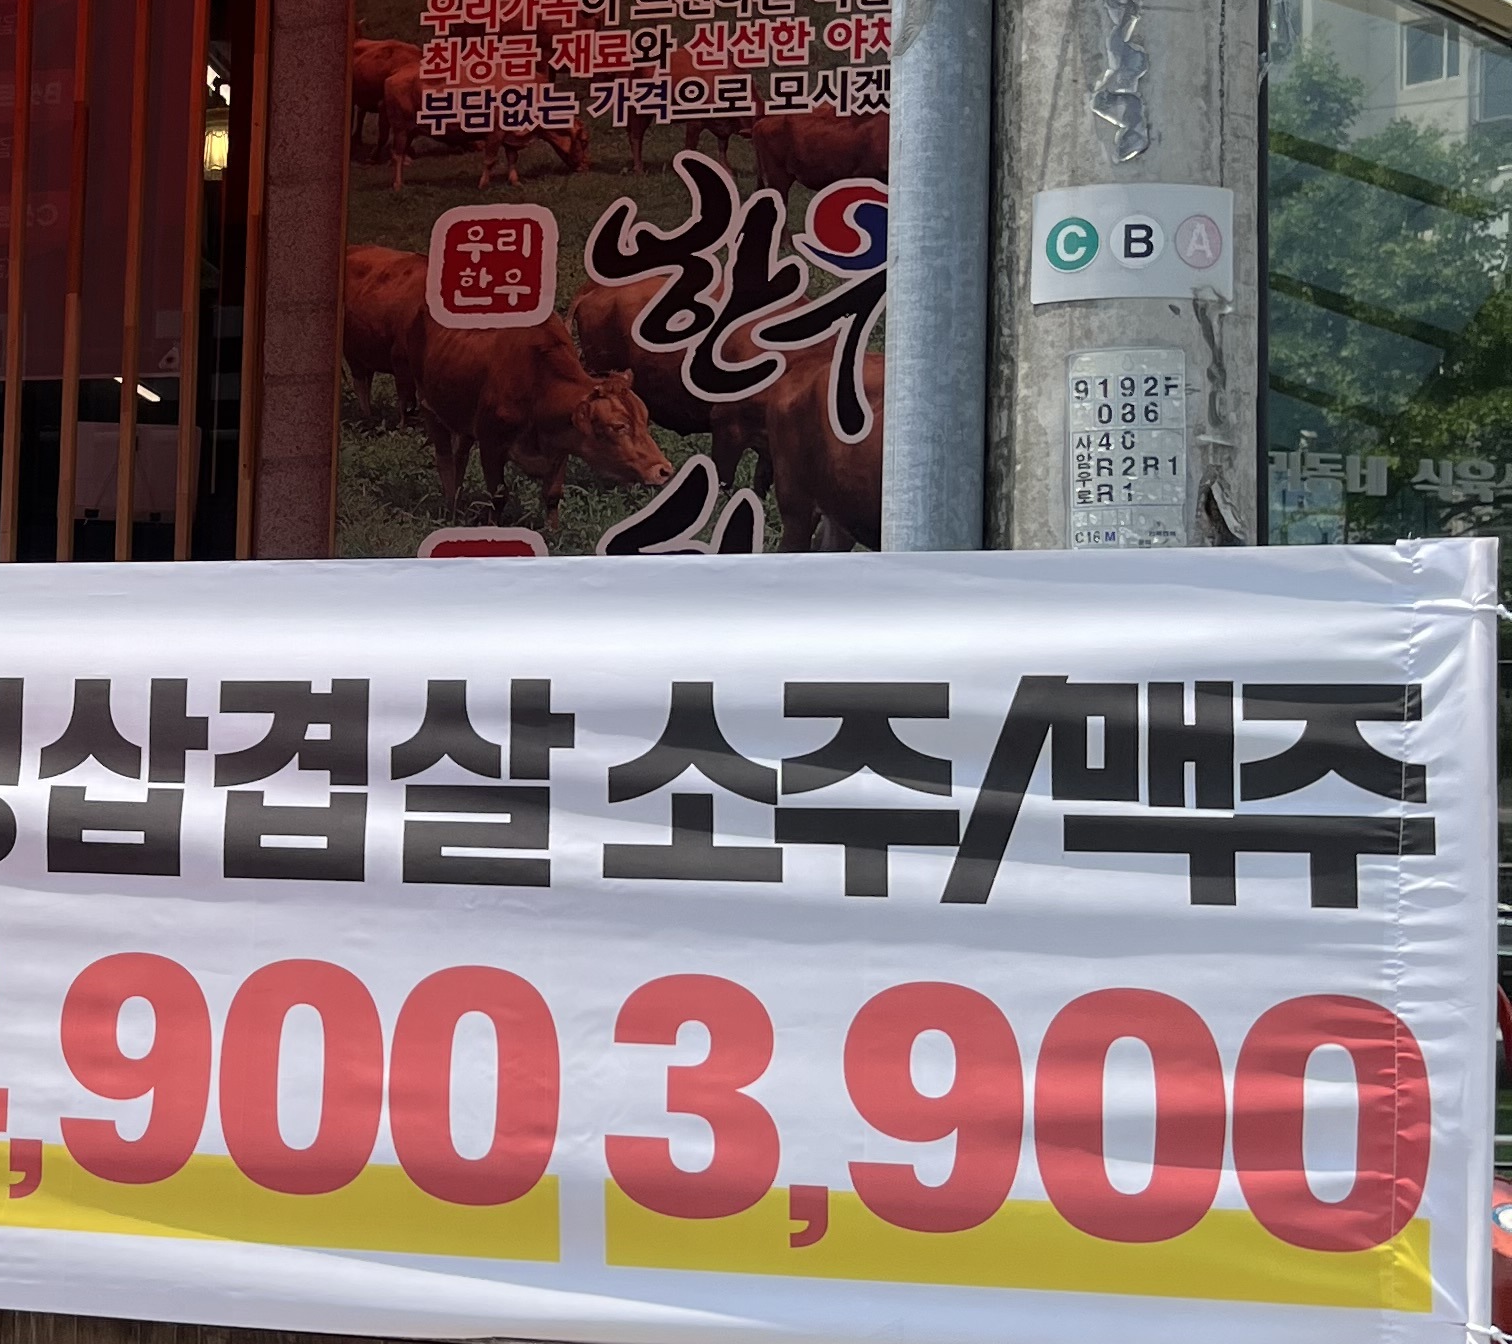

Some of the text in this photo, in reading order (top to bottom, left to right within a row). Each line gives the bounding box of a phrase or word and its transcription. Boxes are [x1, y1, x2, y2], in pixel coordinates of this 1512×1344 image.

[421, 36, 542, 87] 최상급
[548, 25, 674, 80] 재료와
[689, 19, 812, 72] 신선한
[418, 84, 579, 134] 부담없는
[587, 76, 755, 126] 가격으로
[456, 224, 531, 263] 우리
[1054, 223, 1089, 263] C
[1123, 223, 1155, 259] B
[454, 268, 531, 307] 한우
[602, 674, 1435, 908] 소주/맥주
[604, 973, 1431, 1253] 3,900
